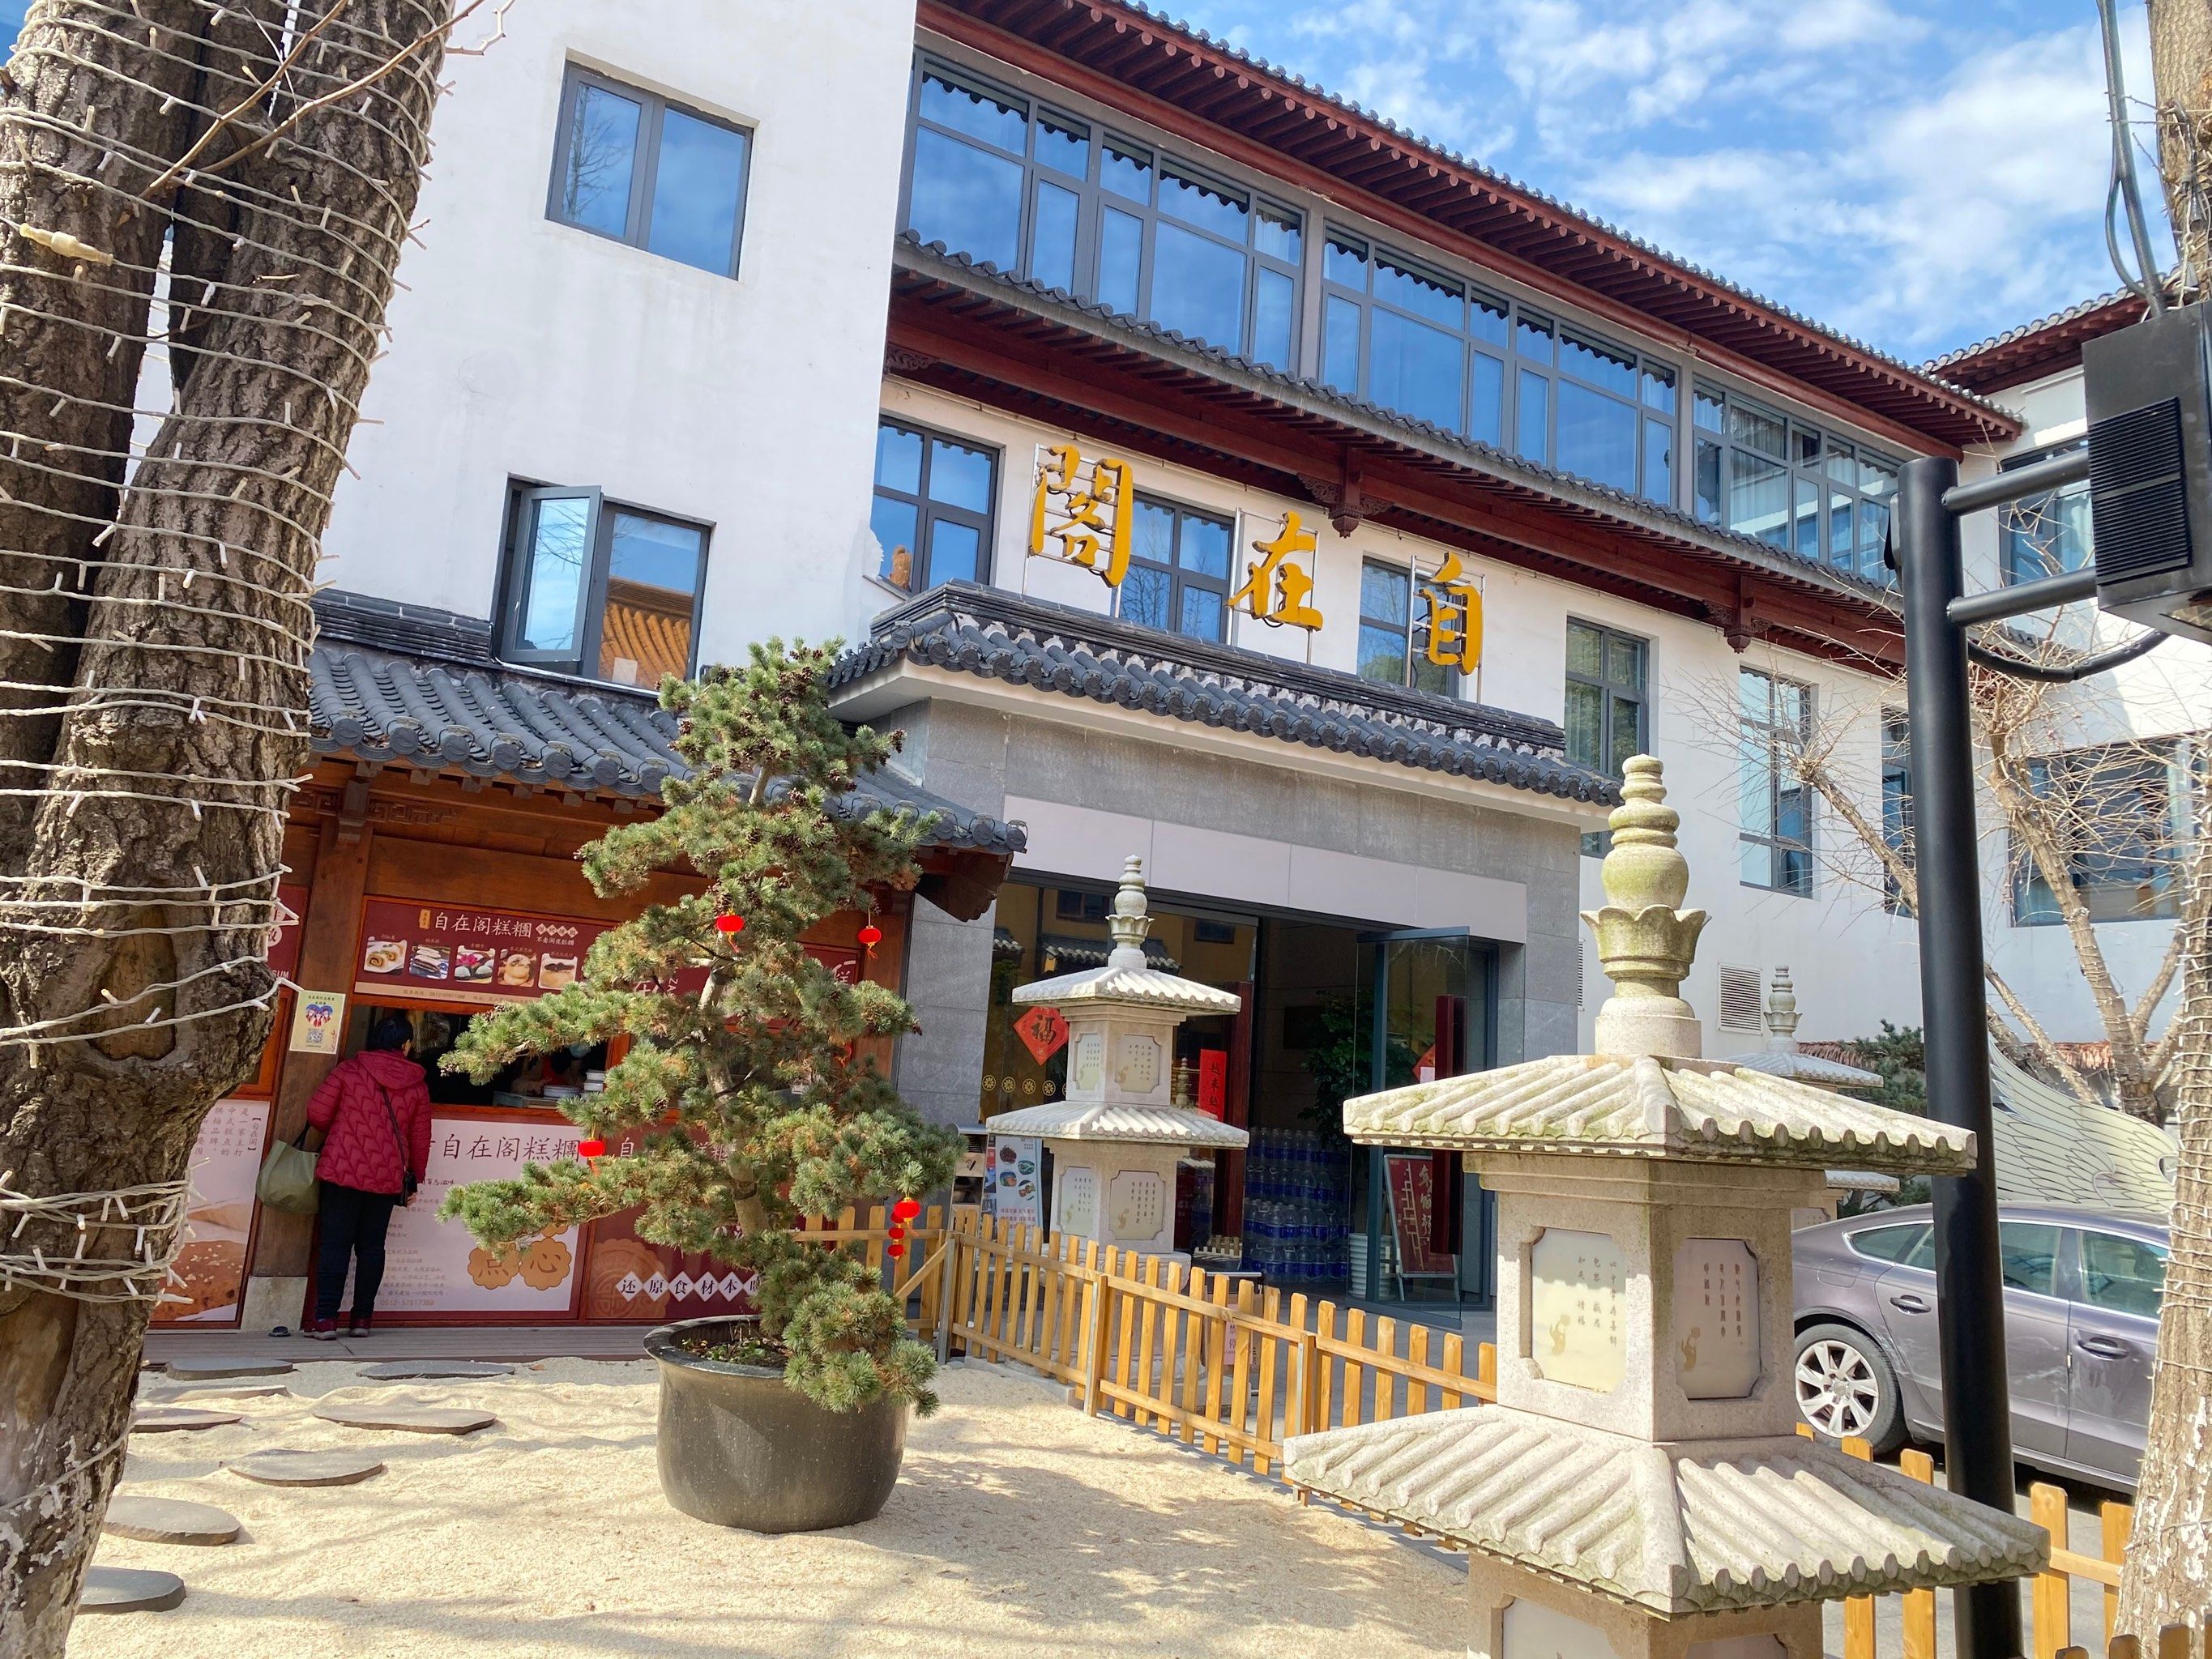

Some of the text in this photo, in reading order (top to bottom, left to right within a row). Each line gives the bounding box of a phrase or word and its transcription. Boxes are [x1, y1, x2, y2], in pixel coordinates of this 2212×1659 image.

[1031, 1014, 1057, 1045] 福
[234, 1107, 249, 1157] 是一家主打
